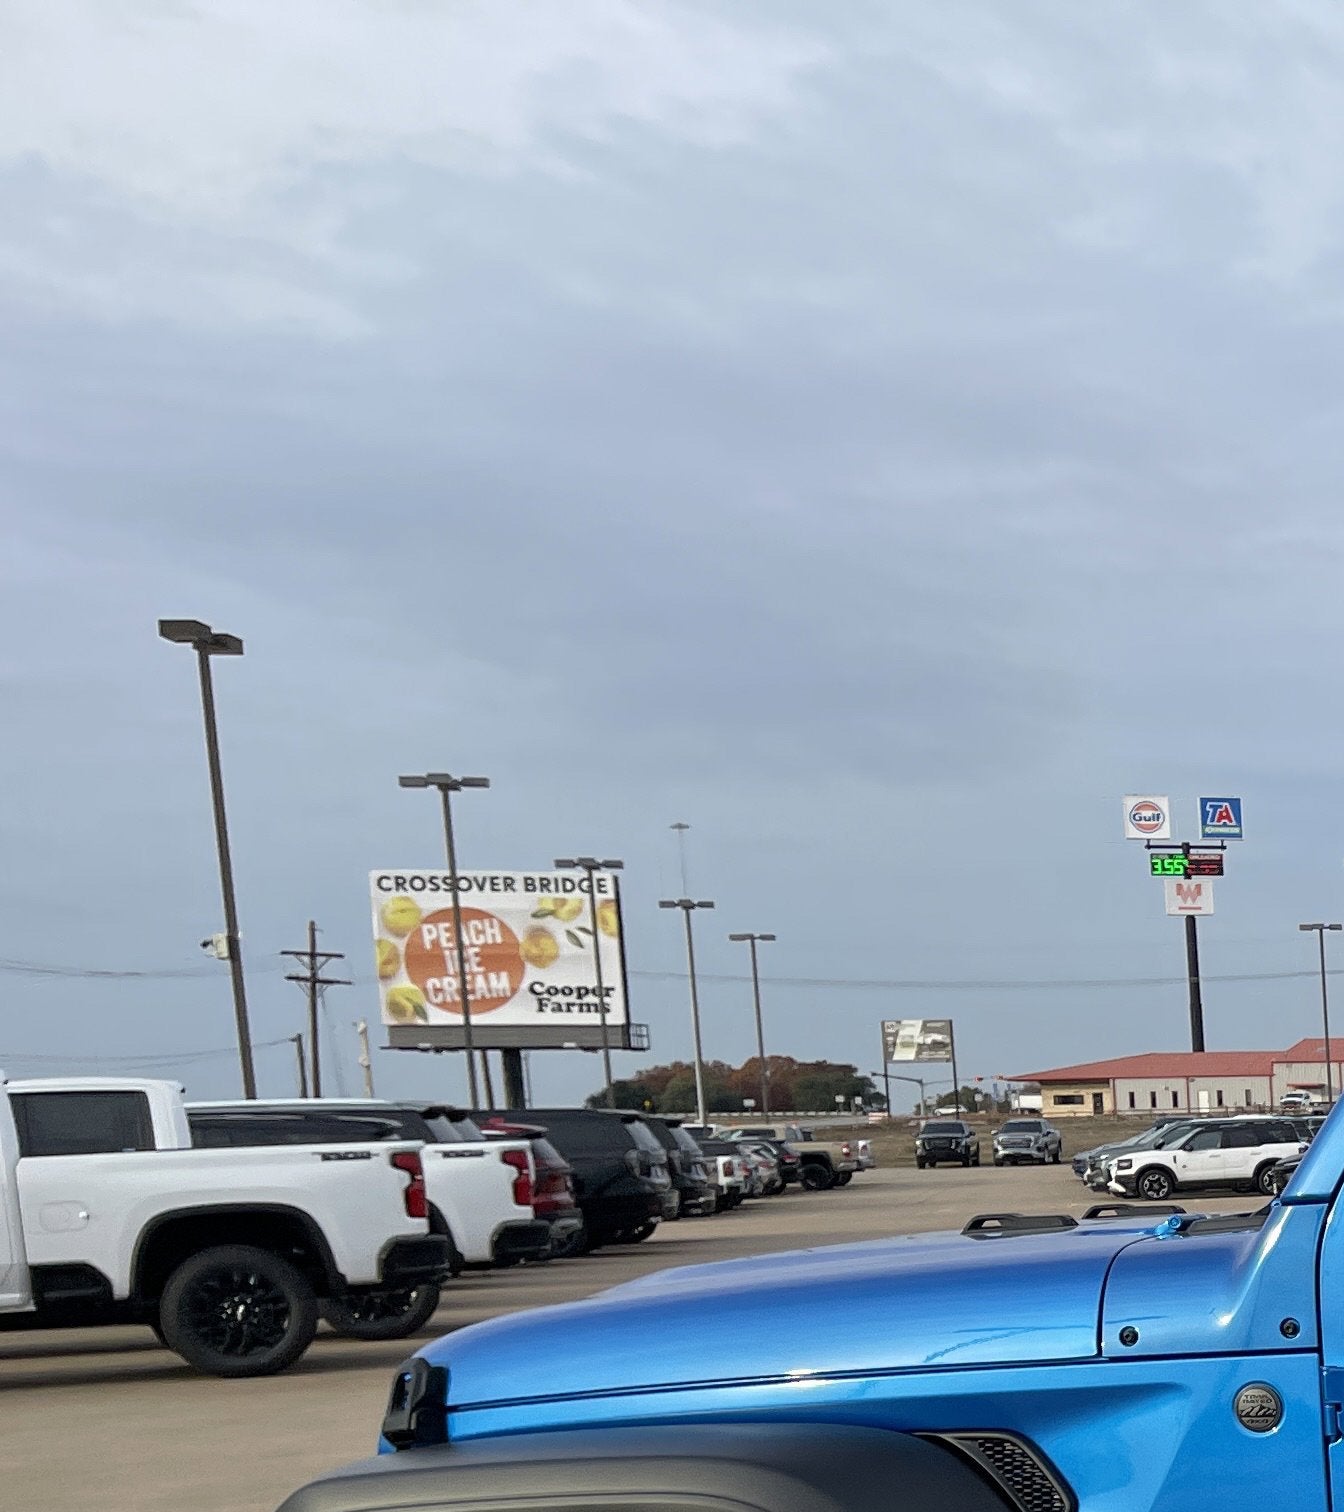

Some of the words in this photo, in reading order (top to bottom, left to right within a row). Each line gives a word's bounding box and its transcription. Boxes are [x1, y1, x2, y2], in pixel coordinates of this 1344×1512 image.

[1132, 812, 1161, 823] Gulf
[1206, 802, 1237, 825] TA
[376, 875, 517, 892] CROSSOVER
[523, 876, 608, 894] BRIDGE
[421, 918, 503, 951] PEACH
[443, 946, 486, 975] ICE
[426, 971, 511, 1004] CREAM
[528, 981, 615, 1000] Cooper
[537, 997, 611, 1013] Farms
